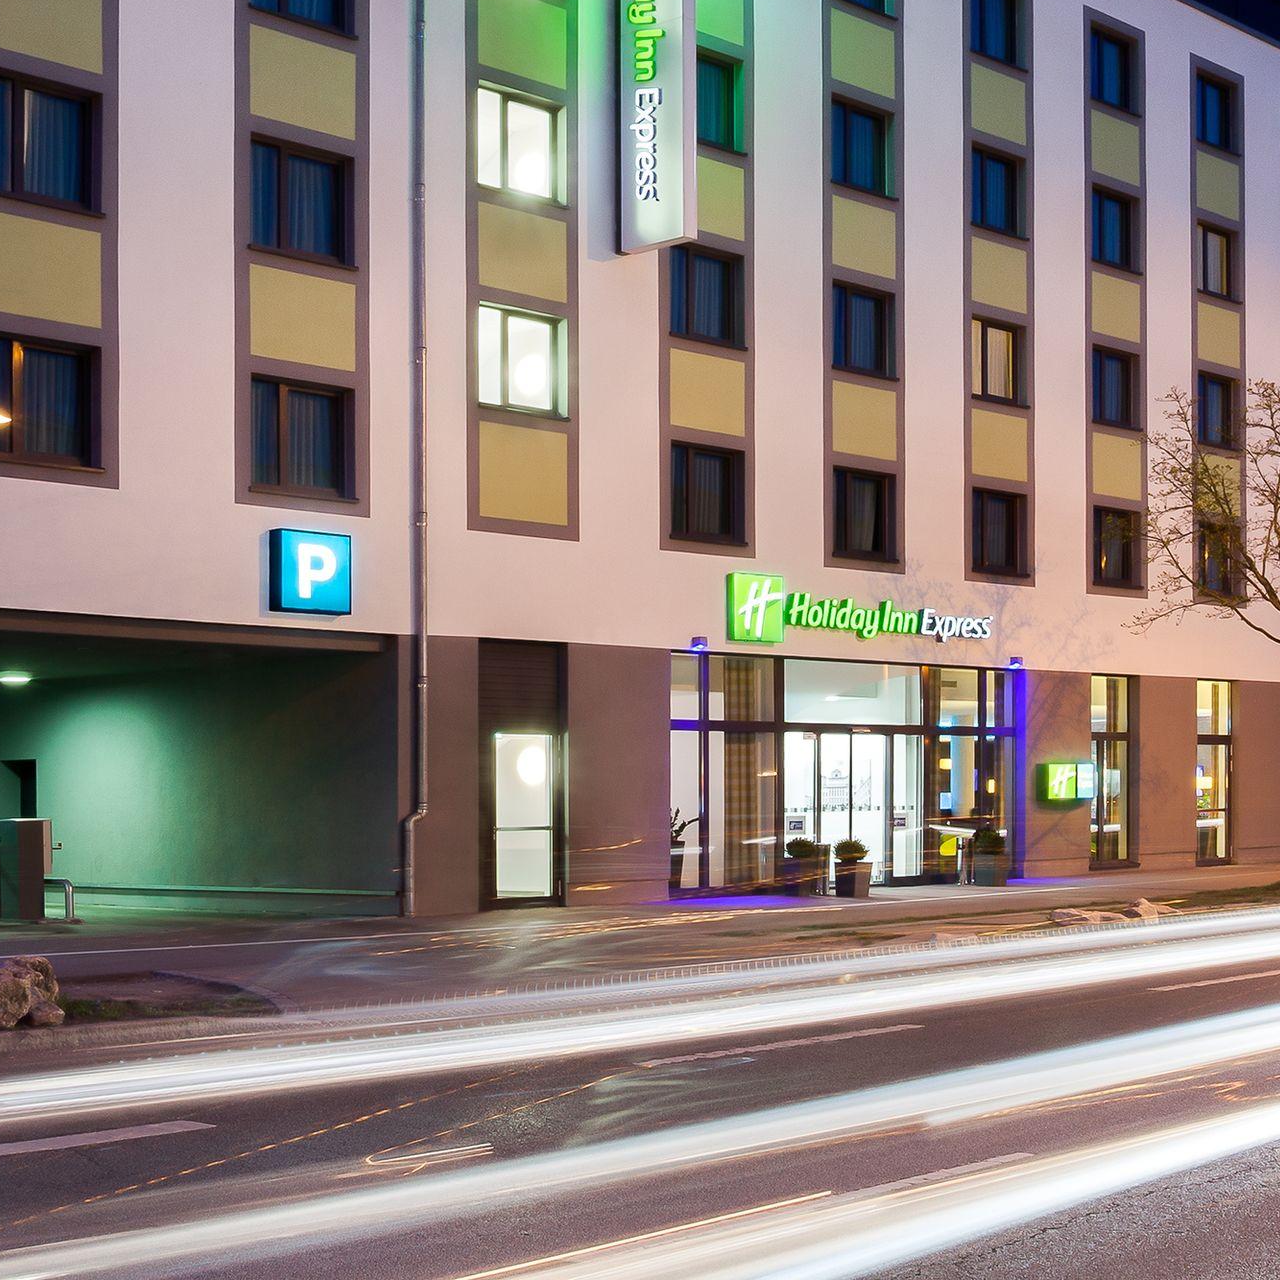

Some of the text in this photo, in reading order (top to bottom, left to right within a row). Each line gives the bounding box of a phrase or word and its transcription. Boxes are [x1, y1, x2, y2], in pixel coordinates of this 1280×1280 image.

[635, 29, 663, 82] Inn
[629, 87, 662, 202] Express
[297, 543, 337, 599] P
[788, 592, 993, 643] Holiday Inn Express
